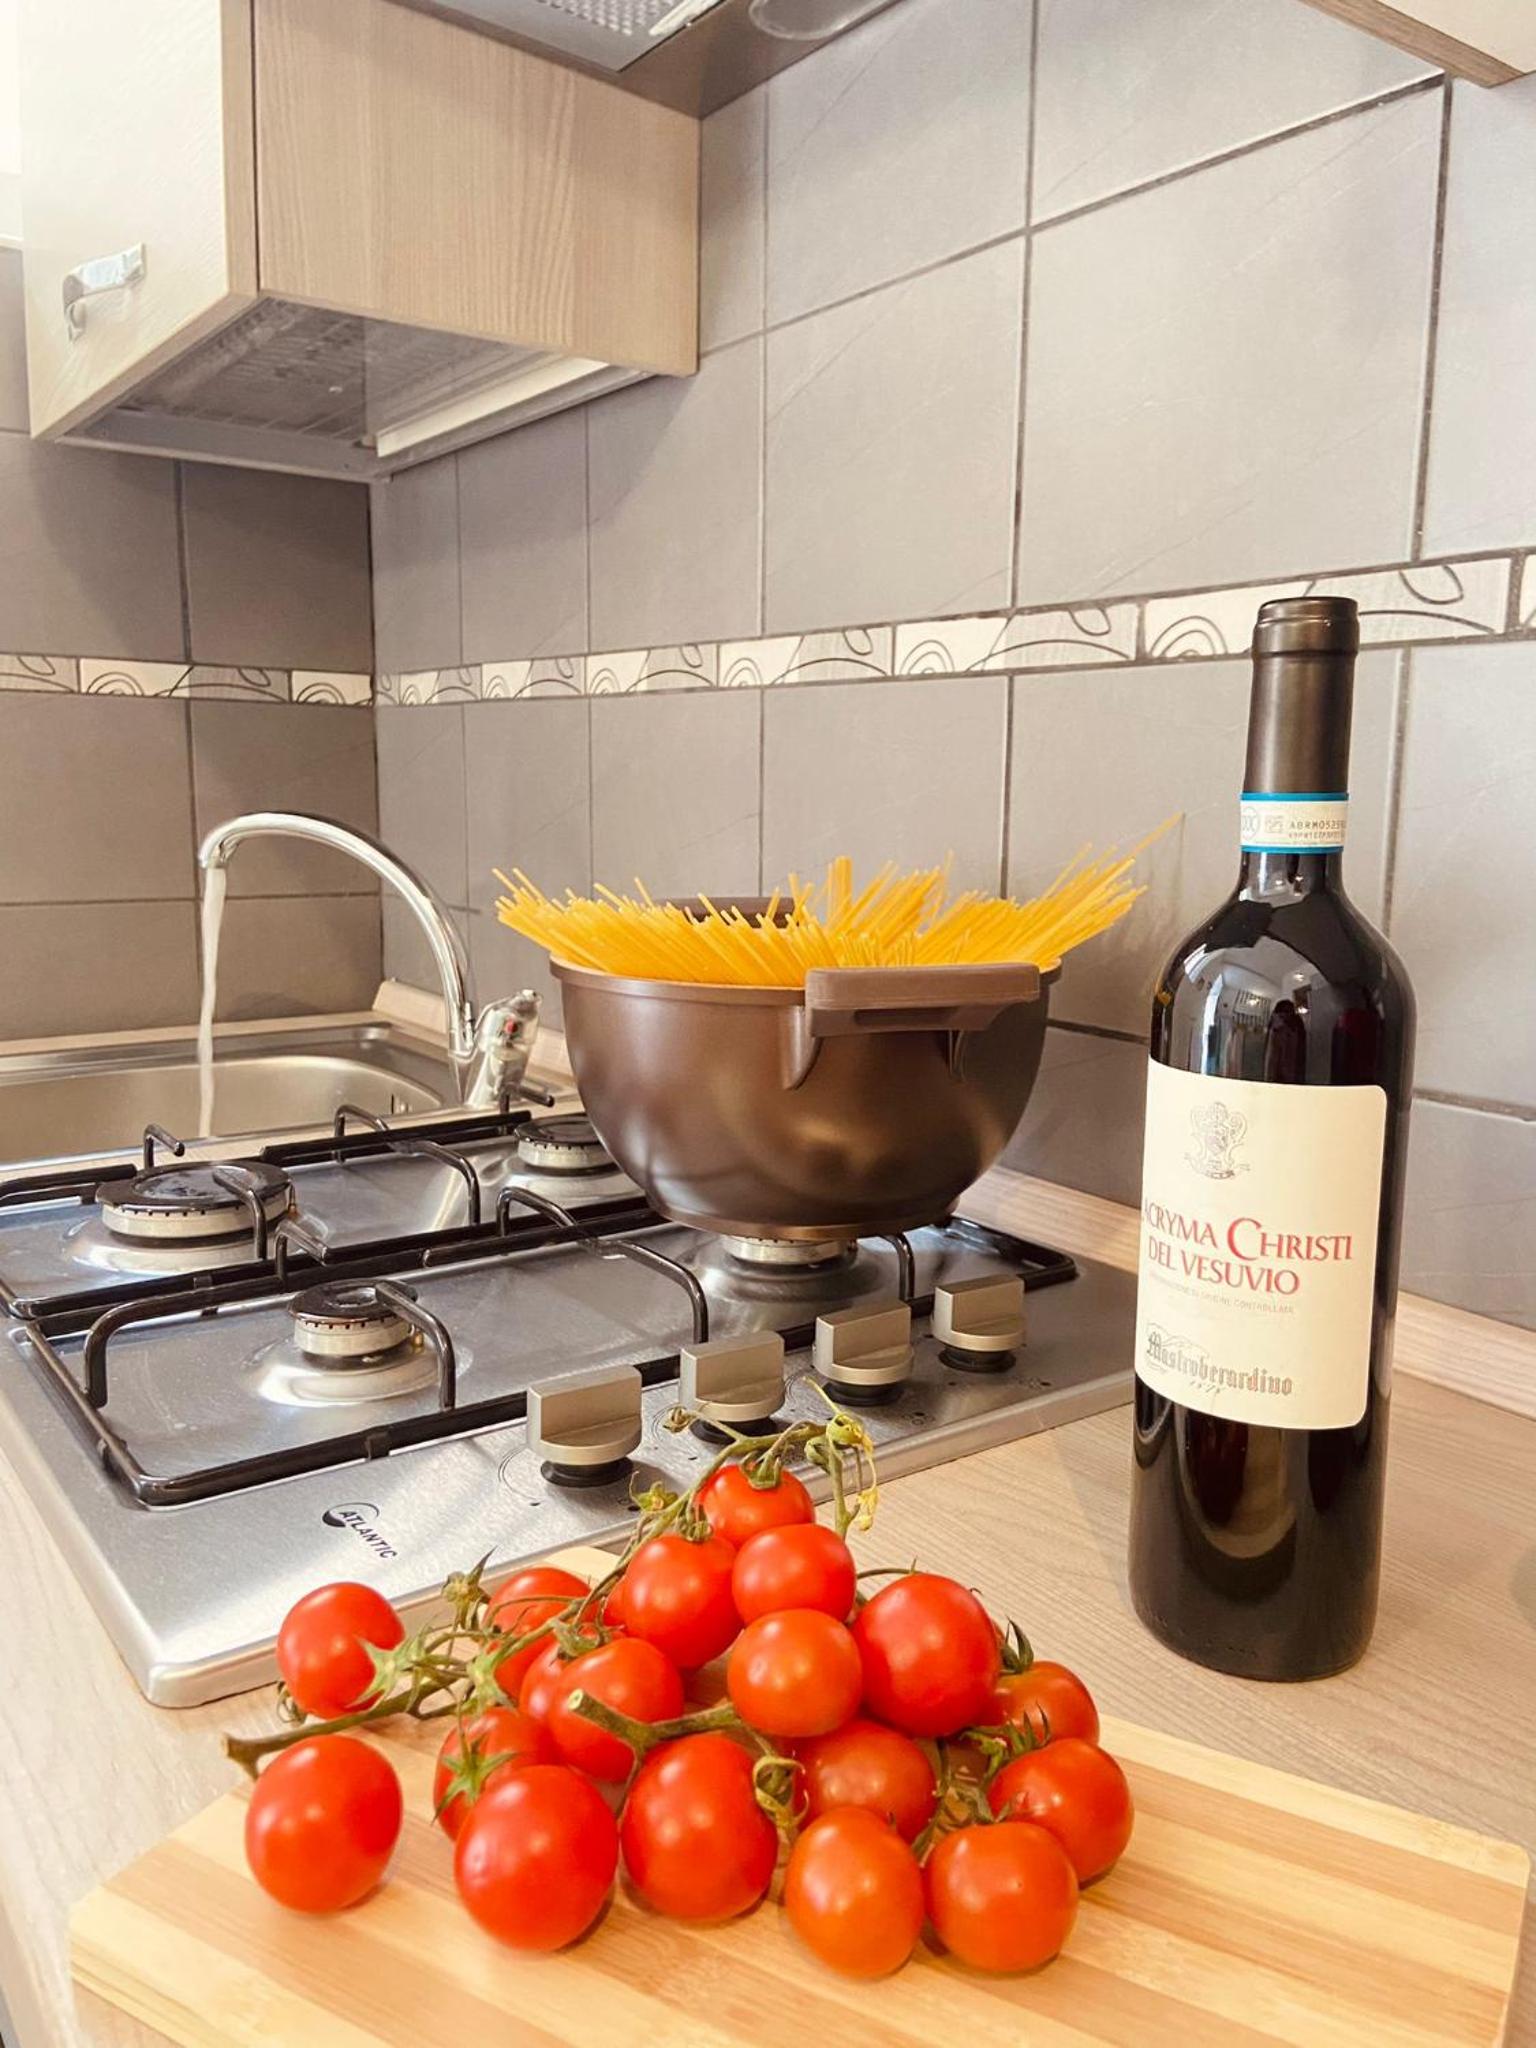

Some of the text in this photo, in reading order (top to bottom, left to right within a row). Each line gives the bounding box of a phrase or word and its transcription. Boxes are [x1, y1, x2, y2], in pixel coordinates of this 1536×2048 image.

[1148, 1235, 1177, 1271] DEL
[1181, 1249, 1300, 1295] VESUVIO
[1227, 1217, 1352, 1261] CHRISTI
[1146, 1331, 1294, 1396] Mastroberardino
[338, 1511, 398, 1558] ATLANTIC
